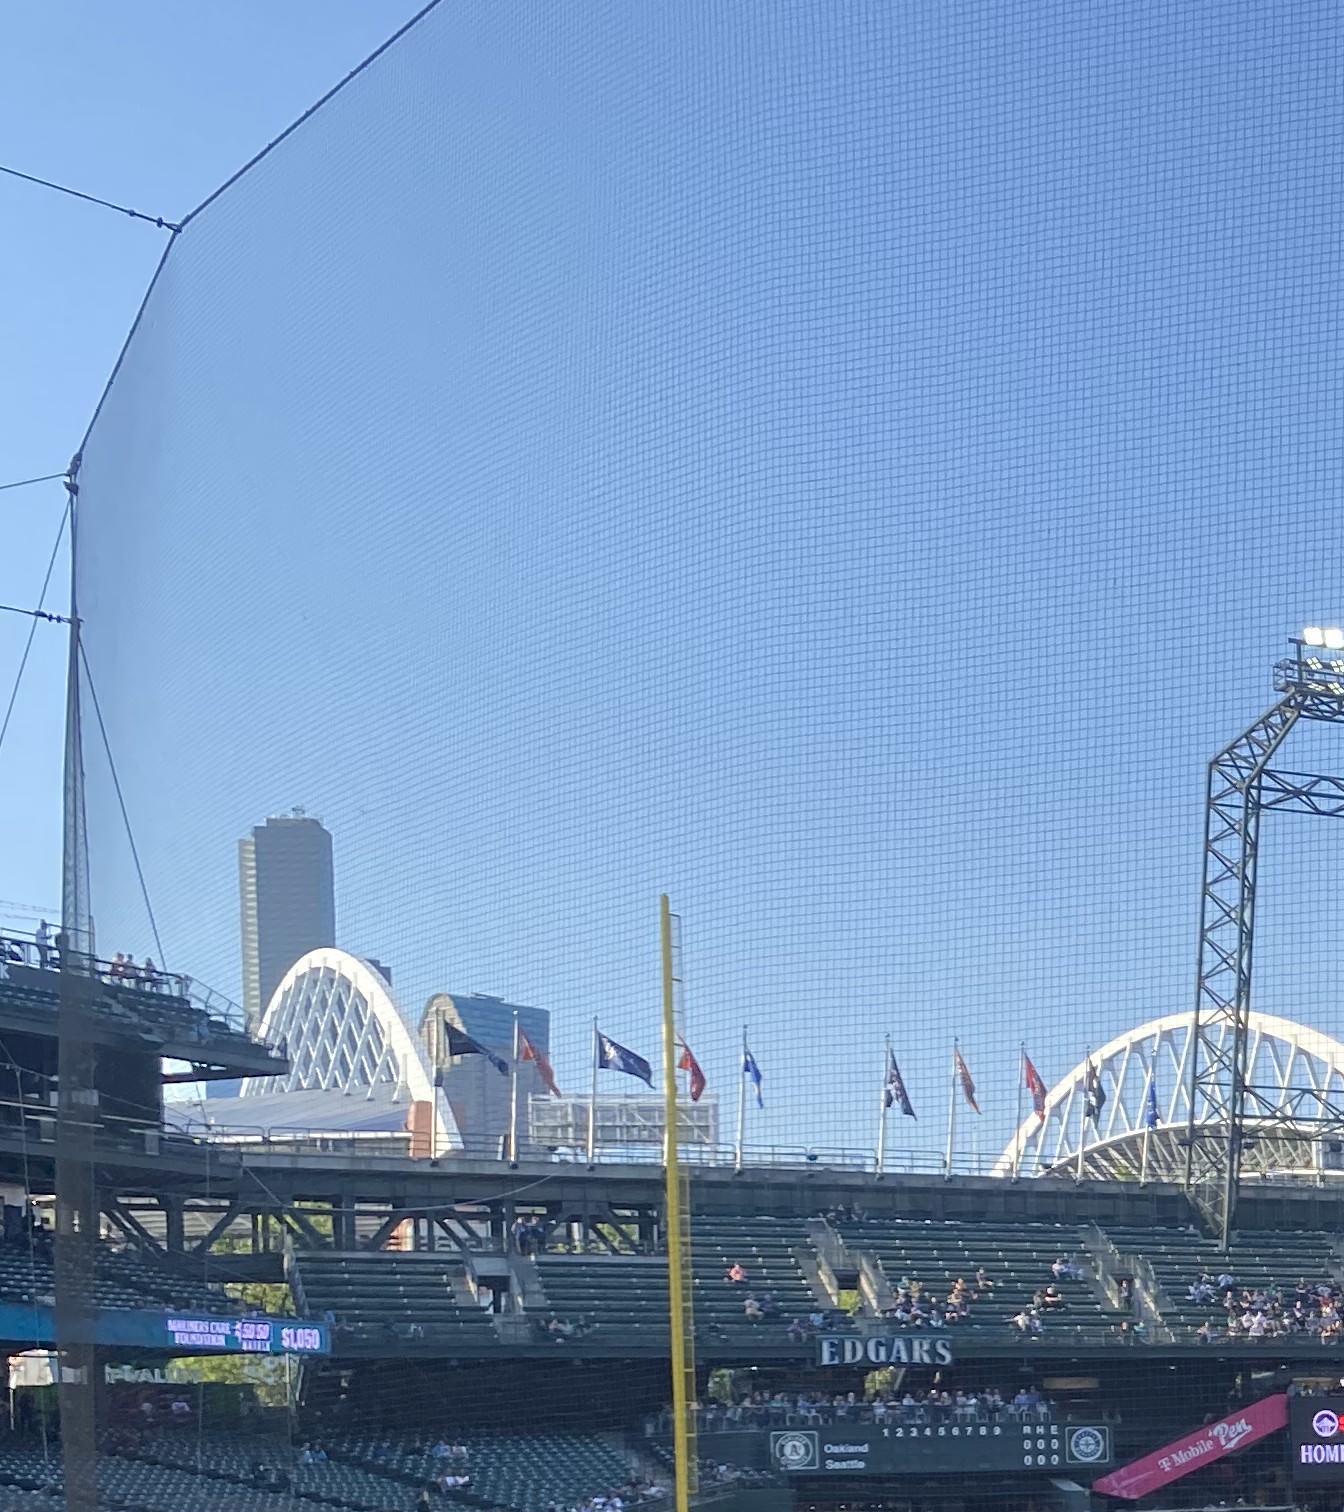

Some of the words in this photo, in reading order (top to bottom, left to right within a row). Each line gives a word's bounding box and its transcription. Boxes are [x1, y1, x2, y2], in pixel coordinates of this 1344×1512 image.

[281, 1328, 320, 1350] $1,050
[824, 1443, 869, 1454] Oakland
[825, 1459, 865, 1469] Seattle
